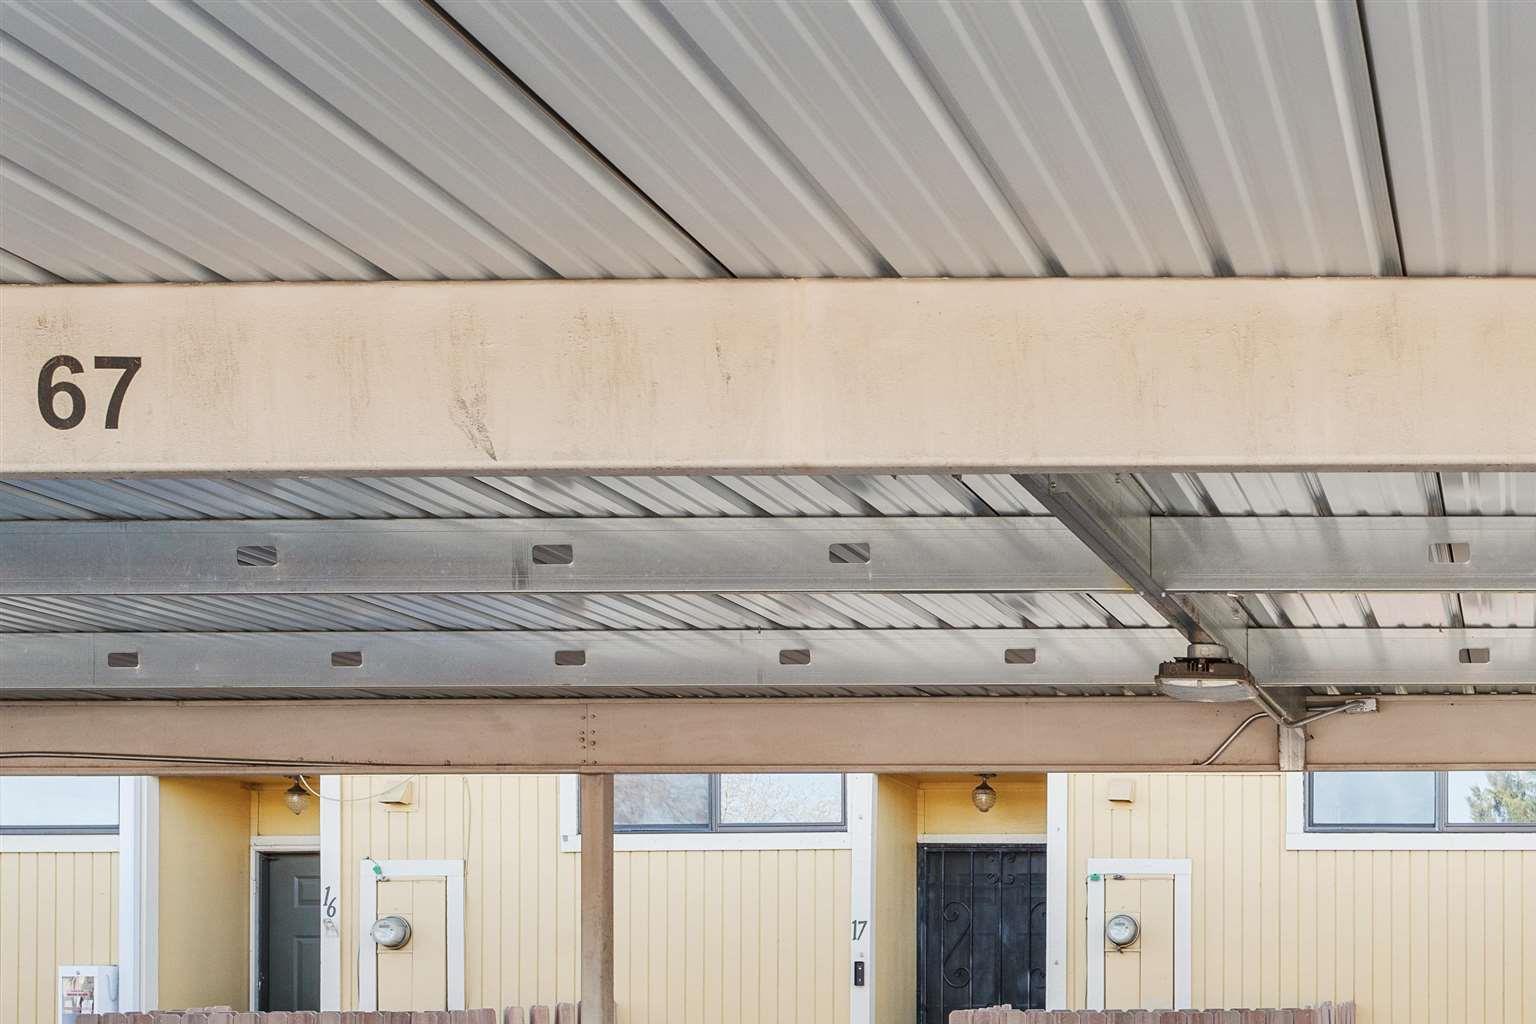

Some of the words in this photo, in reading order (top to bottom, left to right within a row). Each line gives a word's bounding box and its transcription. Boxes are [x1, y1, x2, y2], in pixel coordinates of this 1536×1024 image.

[38, 354, 142, 430] 67
[323, 886, 336, 918] 16
[851, 919, 868, 941] 17
